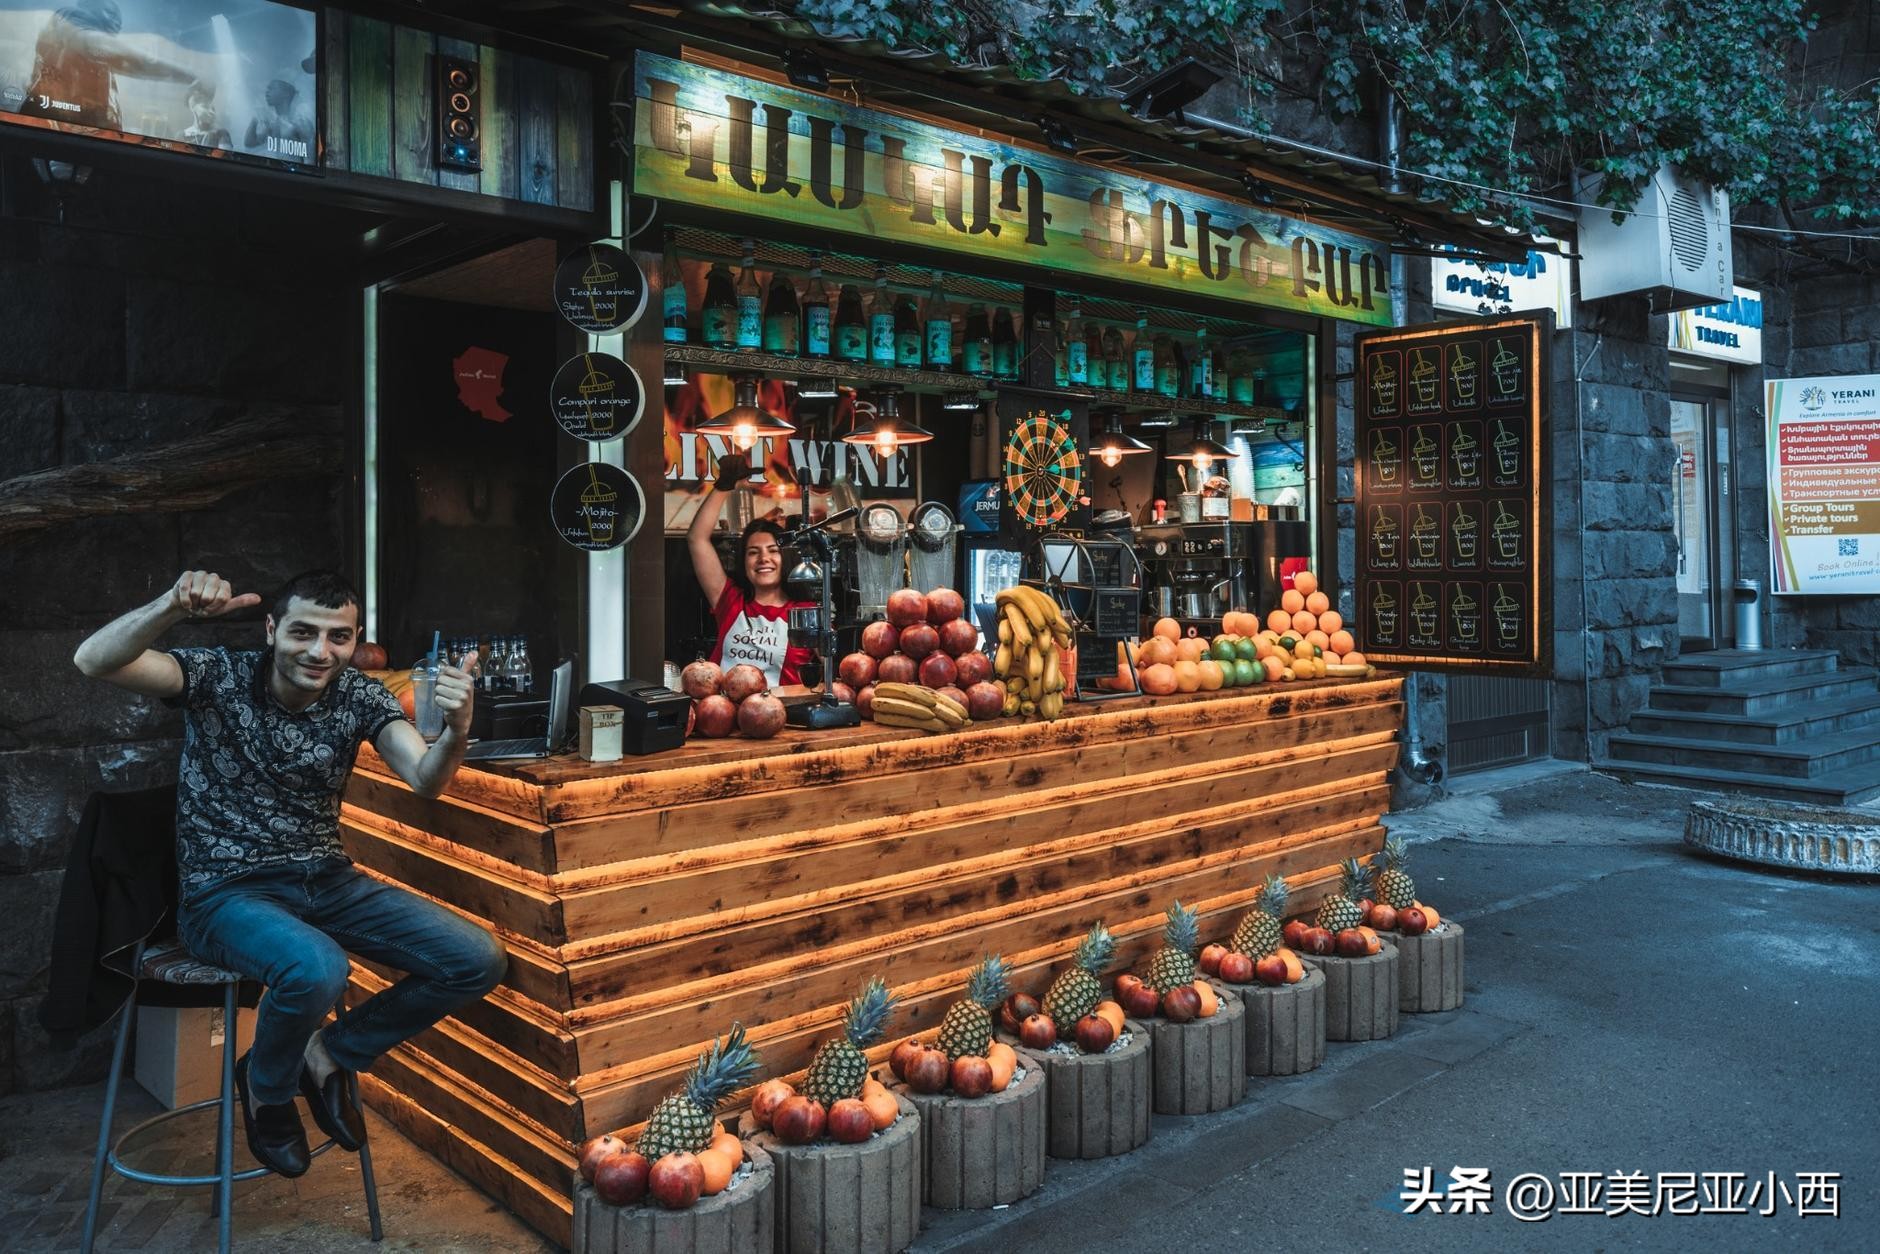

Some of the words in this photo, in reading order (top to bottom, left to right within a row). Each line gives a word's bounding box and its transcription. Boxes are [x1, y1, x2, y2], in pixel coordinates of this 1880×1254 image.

[51, 100, 81, 112] JUVENTUS
[267, 136, 277, 152] DJ
[280, 138, 307, 157] MOMA
[595, 302, 616, 310] 2000
[1695, 325, 1741, 349] TRAVEL
[1831, 389, 1875, 399] YERANI
[592, 411, 613, 419] 2000
[788, 438, 910, 488] WINE
[1788, 468, 1842, 477] Групповые
[1789, 478, 1877, 487] Индивидуальные
[1790, 488, 1860, 498] Транспортные
[1072, 503, 1078, 511] 15
[1790, 504, 1823, 513] Group
[1825, 503, 1855, 512] Tours
[1790, 515, 1828, 523] Private
[1830, 514, 1859, 522] tours
[592, 522, 613, 530] 2000
[1790, 524, 1834, 534] Transfer
[1817, 562, 1840, 571] Book
[1843, 559, 1874, 569] Online
[732, 634, 778, 647] SOCIAL
[729, 647, 774, 666] SOCIAL
